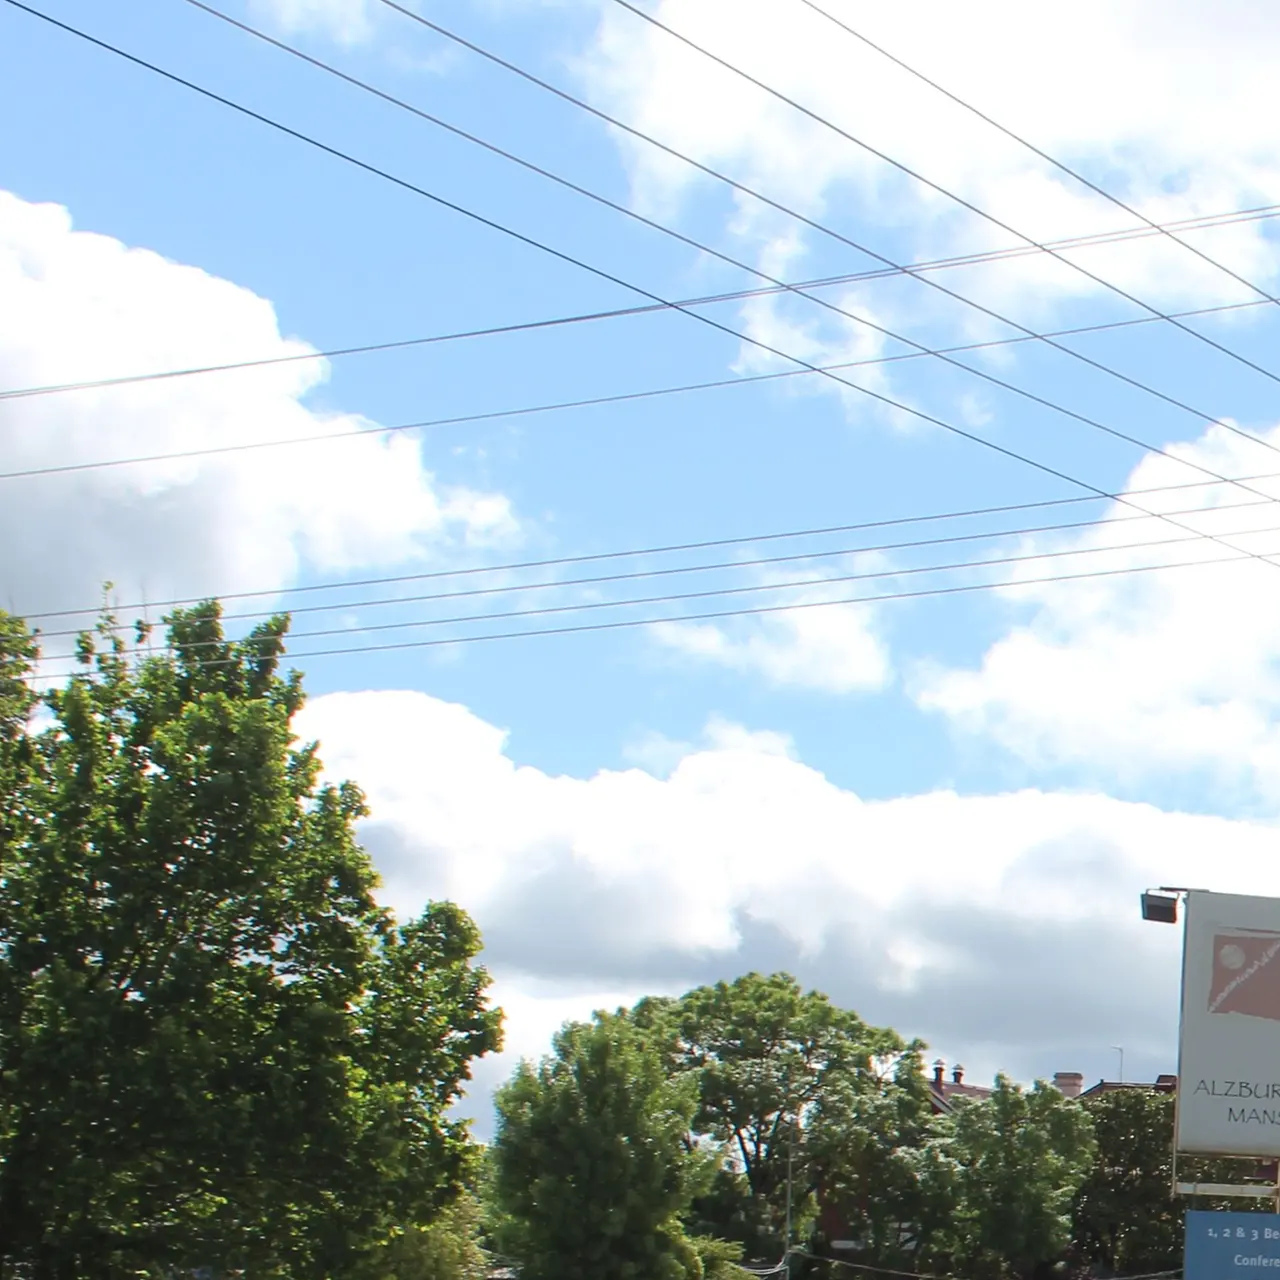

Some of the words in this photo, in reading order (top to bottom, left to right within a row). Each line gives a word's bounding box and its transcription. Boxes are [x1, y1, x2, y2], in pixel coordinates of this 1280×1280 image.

[1223, 1228, 1231, 1238] 2
[1236, 1227, 1246, 1238] &
[1251, 1229, 1259, 1241] 3
